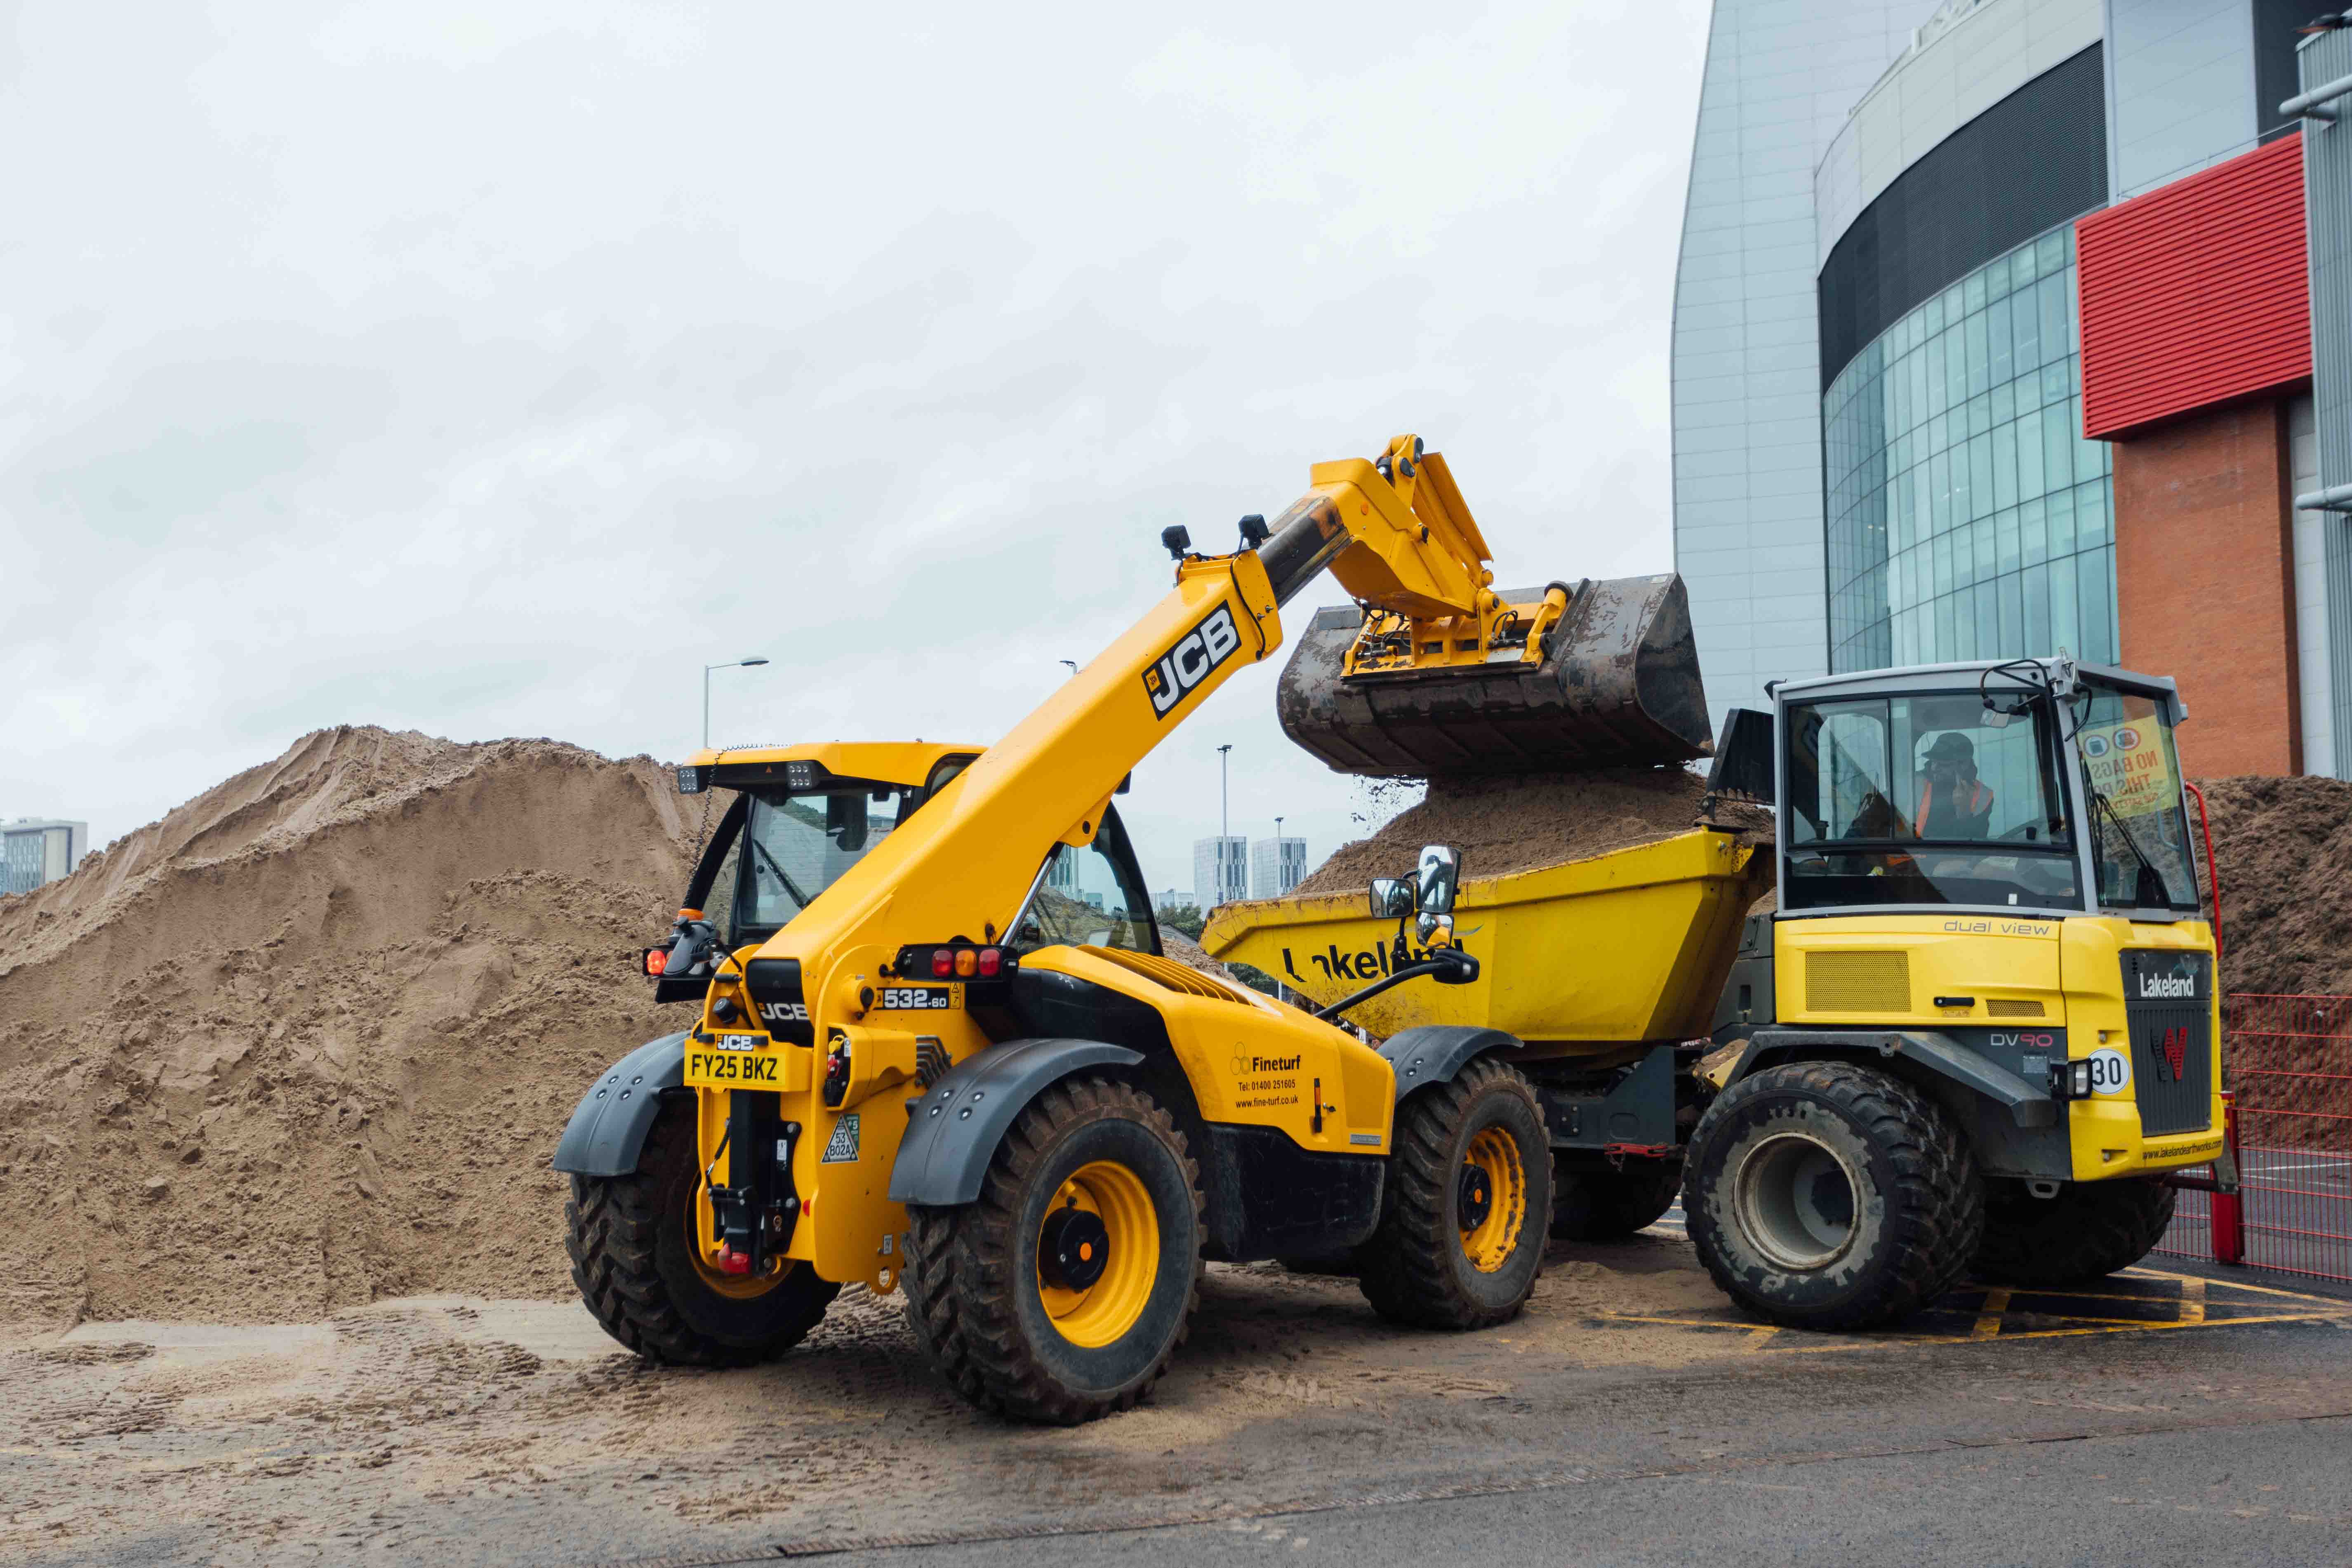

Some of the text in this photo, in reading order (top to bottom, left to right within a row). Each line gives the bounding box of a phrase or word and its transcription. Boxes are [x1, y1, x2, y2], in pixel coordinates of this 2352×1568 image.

[1154, 609, 1237, 711] JCB
[1944, 921, 2049, 935] dual view
[2140, 972, 2194, 997] Lakeland
[760, 1003, 810, 1020] JCB
[717, 1035, 753, 1051] JCB
[1990, 1034, 2053, 1047] DV90
[692, 1054, 777, 1081] FY25 BKZ
[1253, 1055, 1301, 1072] Fineturf
[2092, 1057, 2121, 1085] 30
[1238, 1078, 1296, 1092] Tel: 01400 251605
[1236, 1094, 1299, 1109] www.fine-turf.co.uk
[836, 1132, 845, 1144] 53
[2142, 1139, 2223, 1160] www.lakelandearthworks.com
